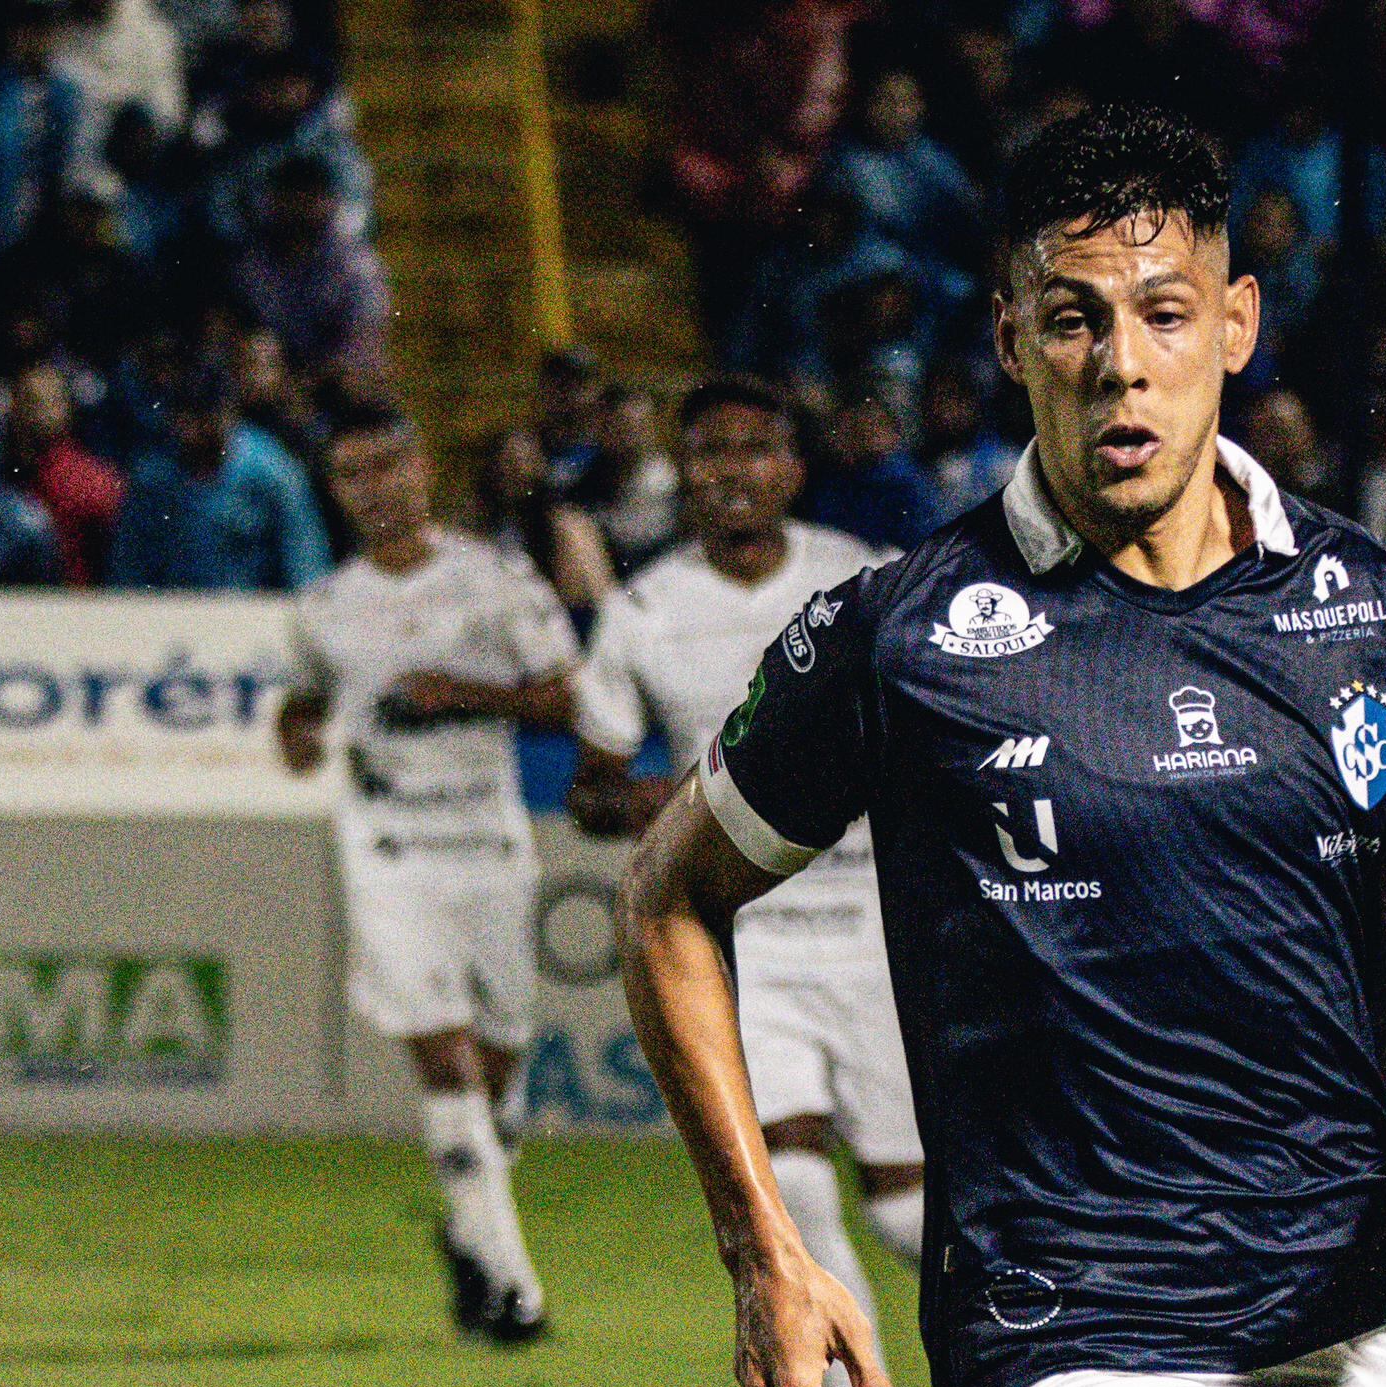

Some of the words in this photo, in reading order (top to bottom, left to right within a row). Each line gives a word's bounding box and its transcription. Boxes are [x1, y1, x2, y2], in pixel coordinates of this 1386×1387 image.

[960, 636, 1027, 656] SALQUI
[1153, 747, 1258, 772] HARIANA
[979, 879, 1019, 902] San
[1023, 878, 1102, 902] Marcos
